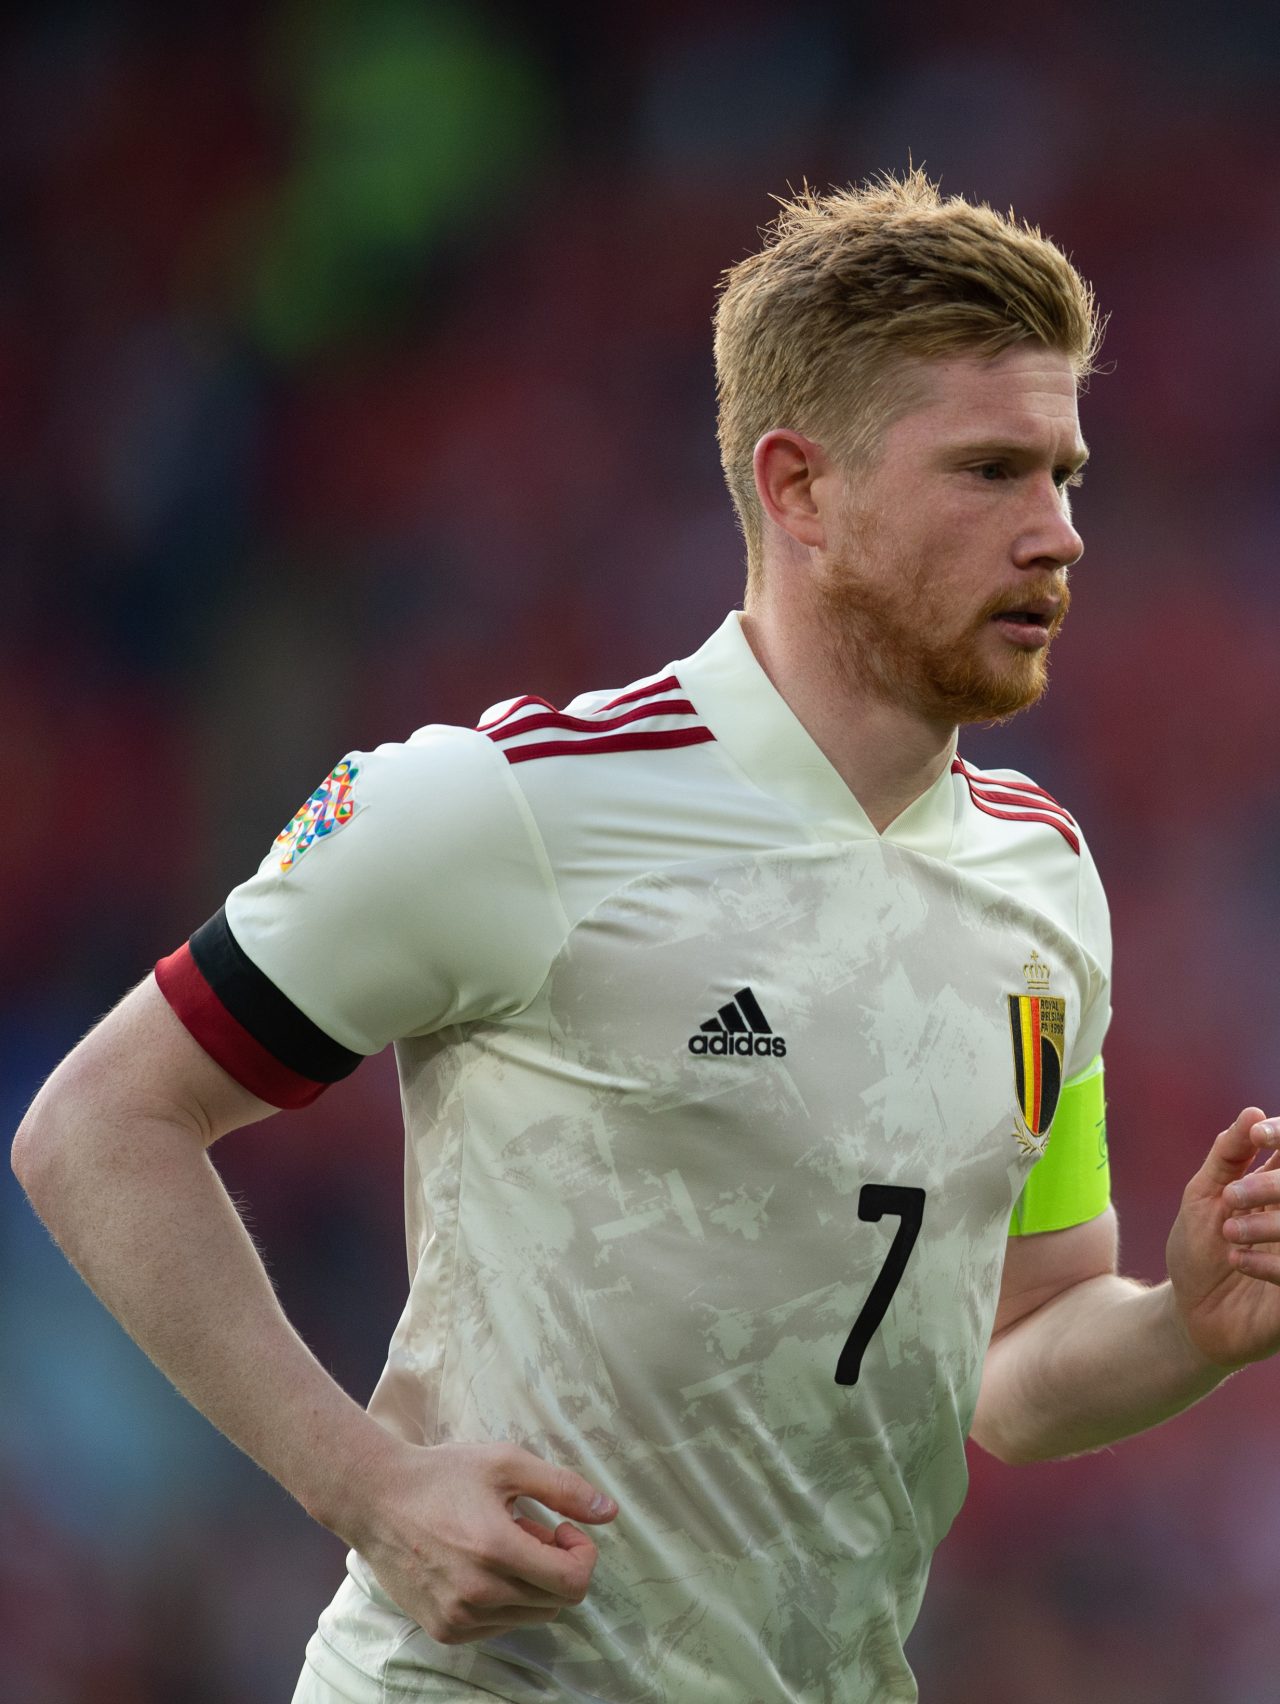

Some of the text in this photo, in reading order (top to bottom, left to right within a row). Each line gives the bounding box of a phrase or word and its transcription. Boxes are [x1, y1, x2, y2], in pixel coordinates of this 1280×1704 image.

[1040, 999, 1059, 1011] ROYAL
[1040, 1022, 1049, 1033] FA
[688, 1030, 787, 1058] adidas
[834, 1183, 926, 1386] 7
